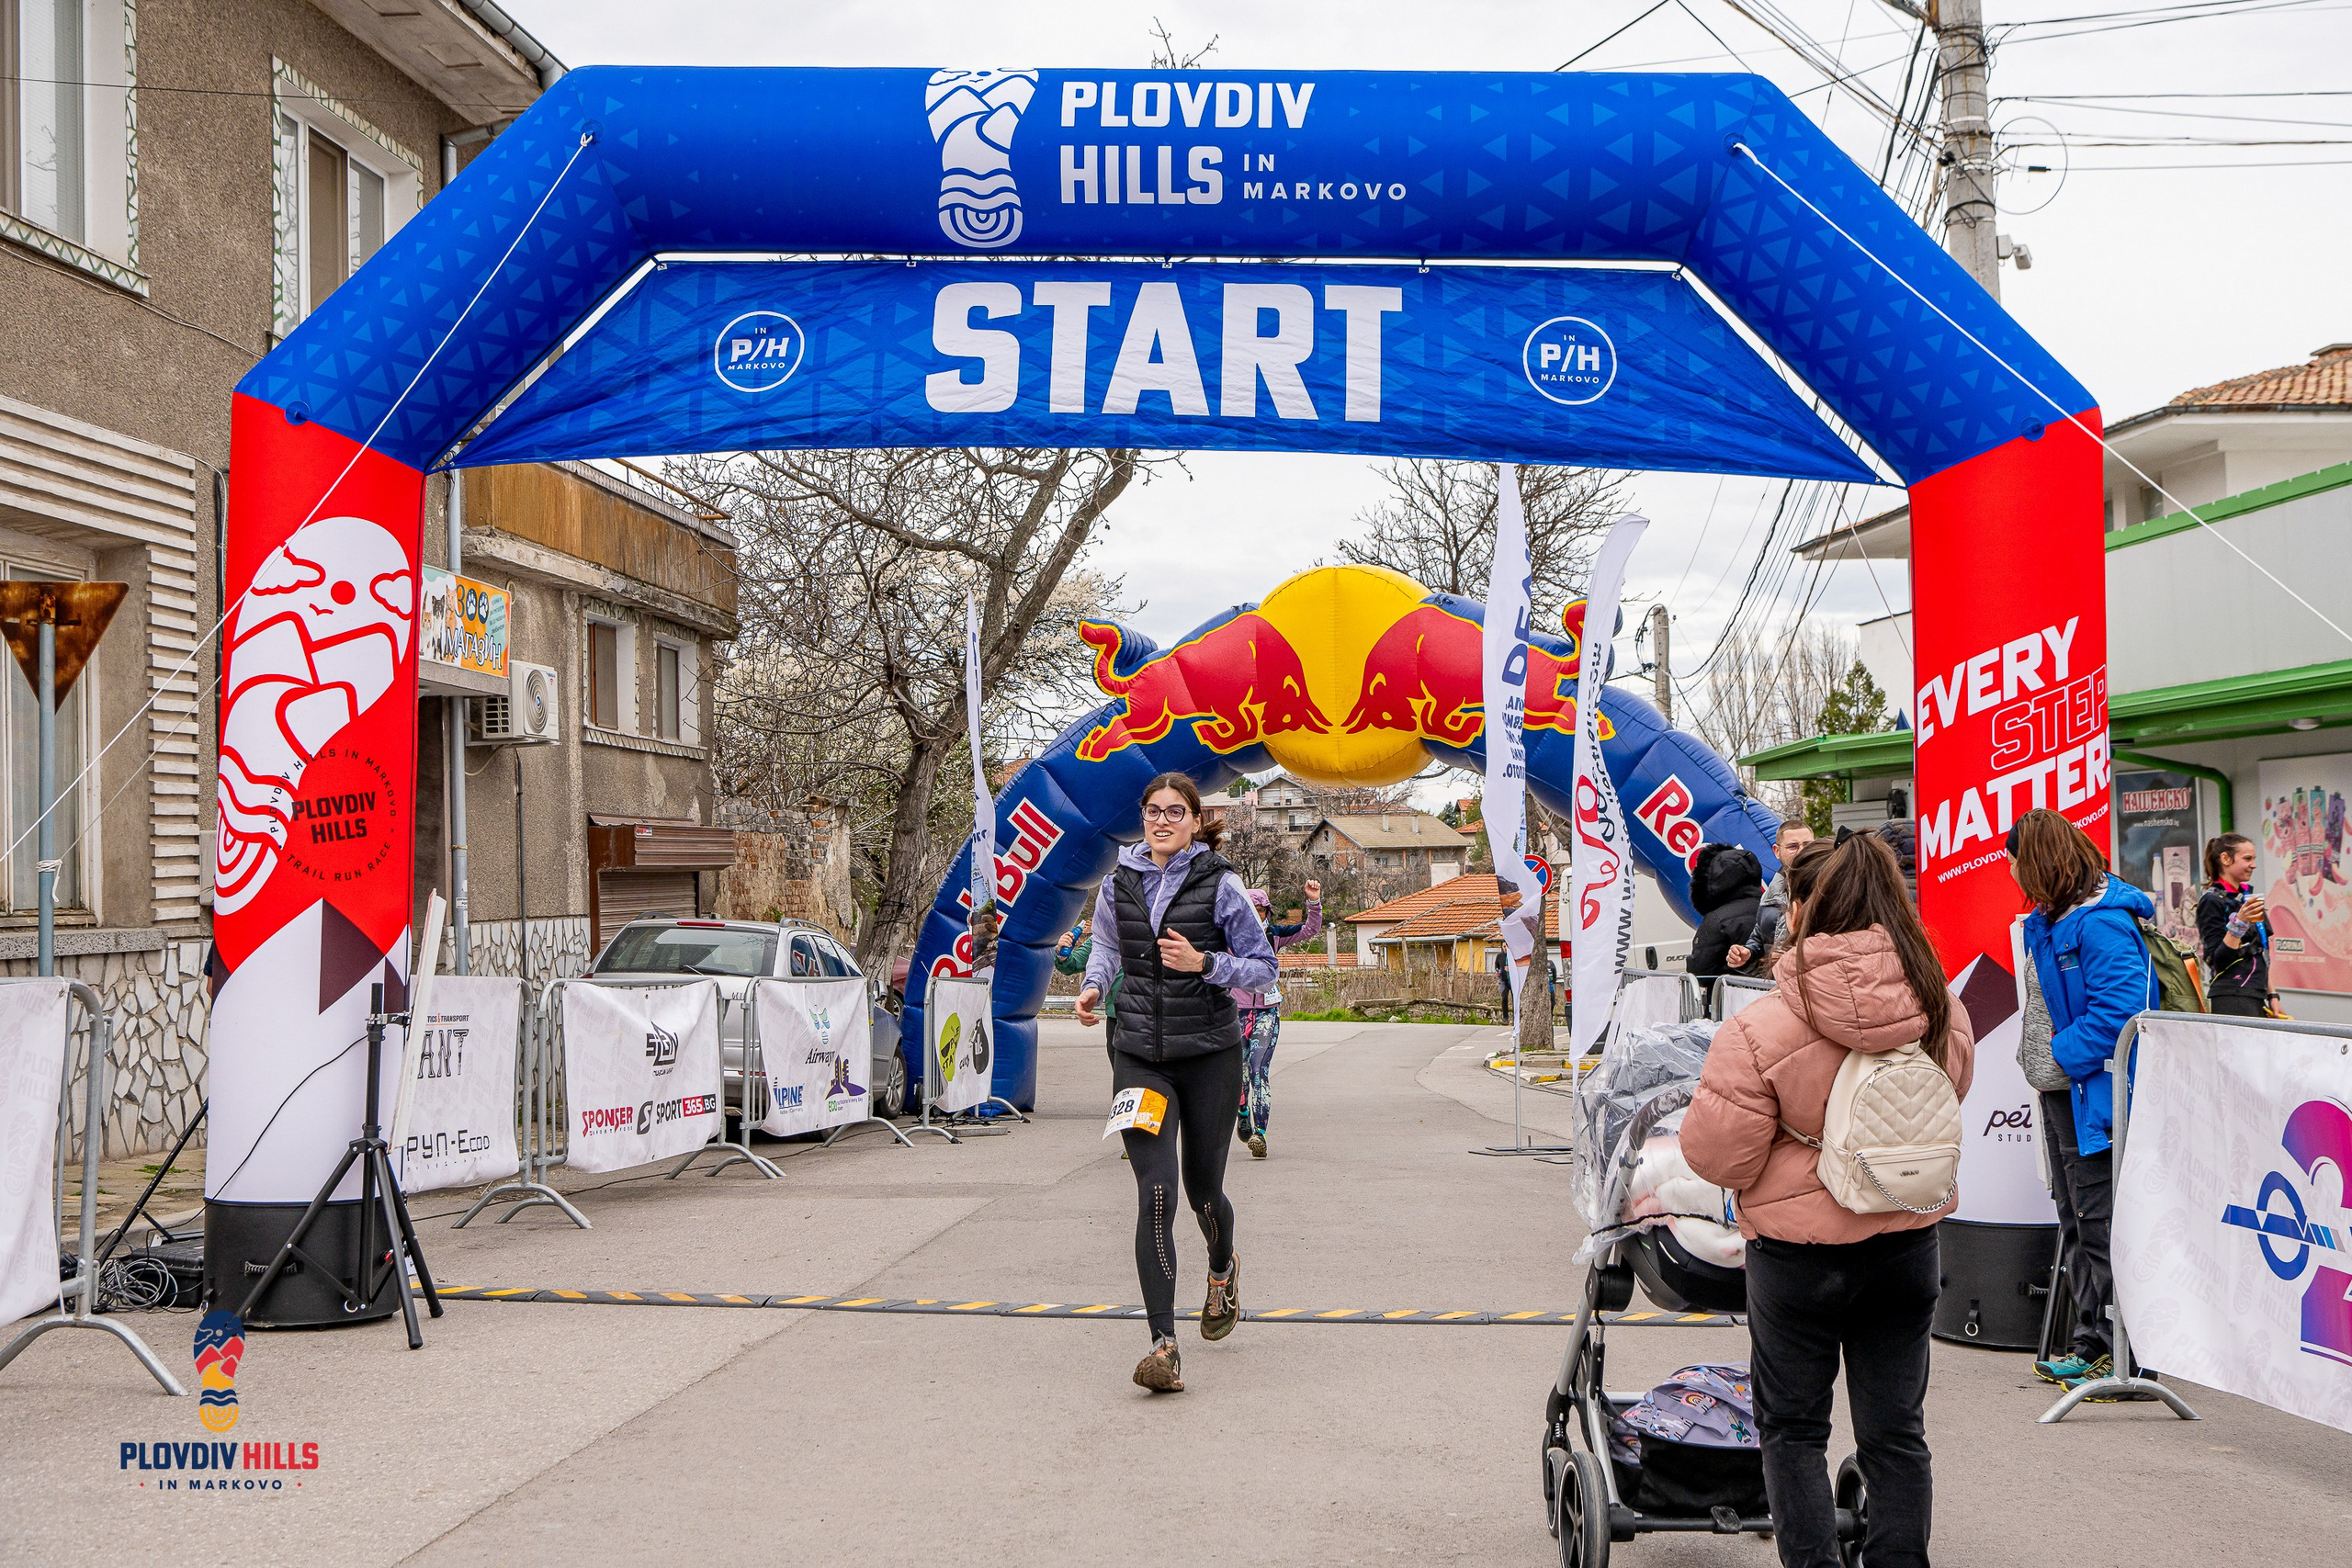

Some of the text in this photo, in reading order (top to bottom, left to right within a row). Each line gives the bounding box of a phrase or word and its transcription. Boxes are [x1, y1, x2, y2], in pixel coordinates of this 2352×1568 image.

[1059, 81, 1316, 129] PLOVDIV
[1059, 145, 1223, 204] HILLS
[1244, 153, 1275, 173] IN
[1243, 182, 1408, 200] MARKOVO
[730, 337, 789, 363] P/H
[924, 281, 1404, 423] START
[1540, 343, 1600, 372] P/H
[727, 362, 786, 370] MARKOVO
[1540, 374, 1600, 384] MARKOVO
[446, 626, 502, 670] МАГАЗИН
[1917, 615, 2079, 749] EVERY
[1991, 663, 2107, 771] STEP
[269, 749, 396, 833] PLOVDIV HILLS IN MARKOVO
[291, 791, 376, 821] PLOVDIV
[2122, 787, 2190, 813] НАШЕНСКО
[311, 818, 368, 844] HILLS
[287, 842, 391, 882] TRAIL RUN RACE
[994, 802, 1059, 902] Bull
[582, 1106, 633, 1137] SPONSER
